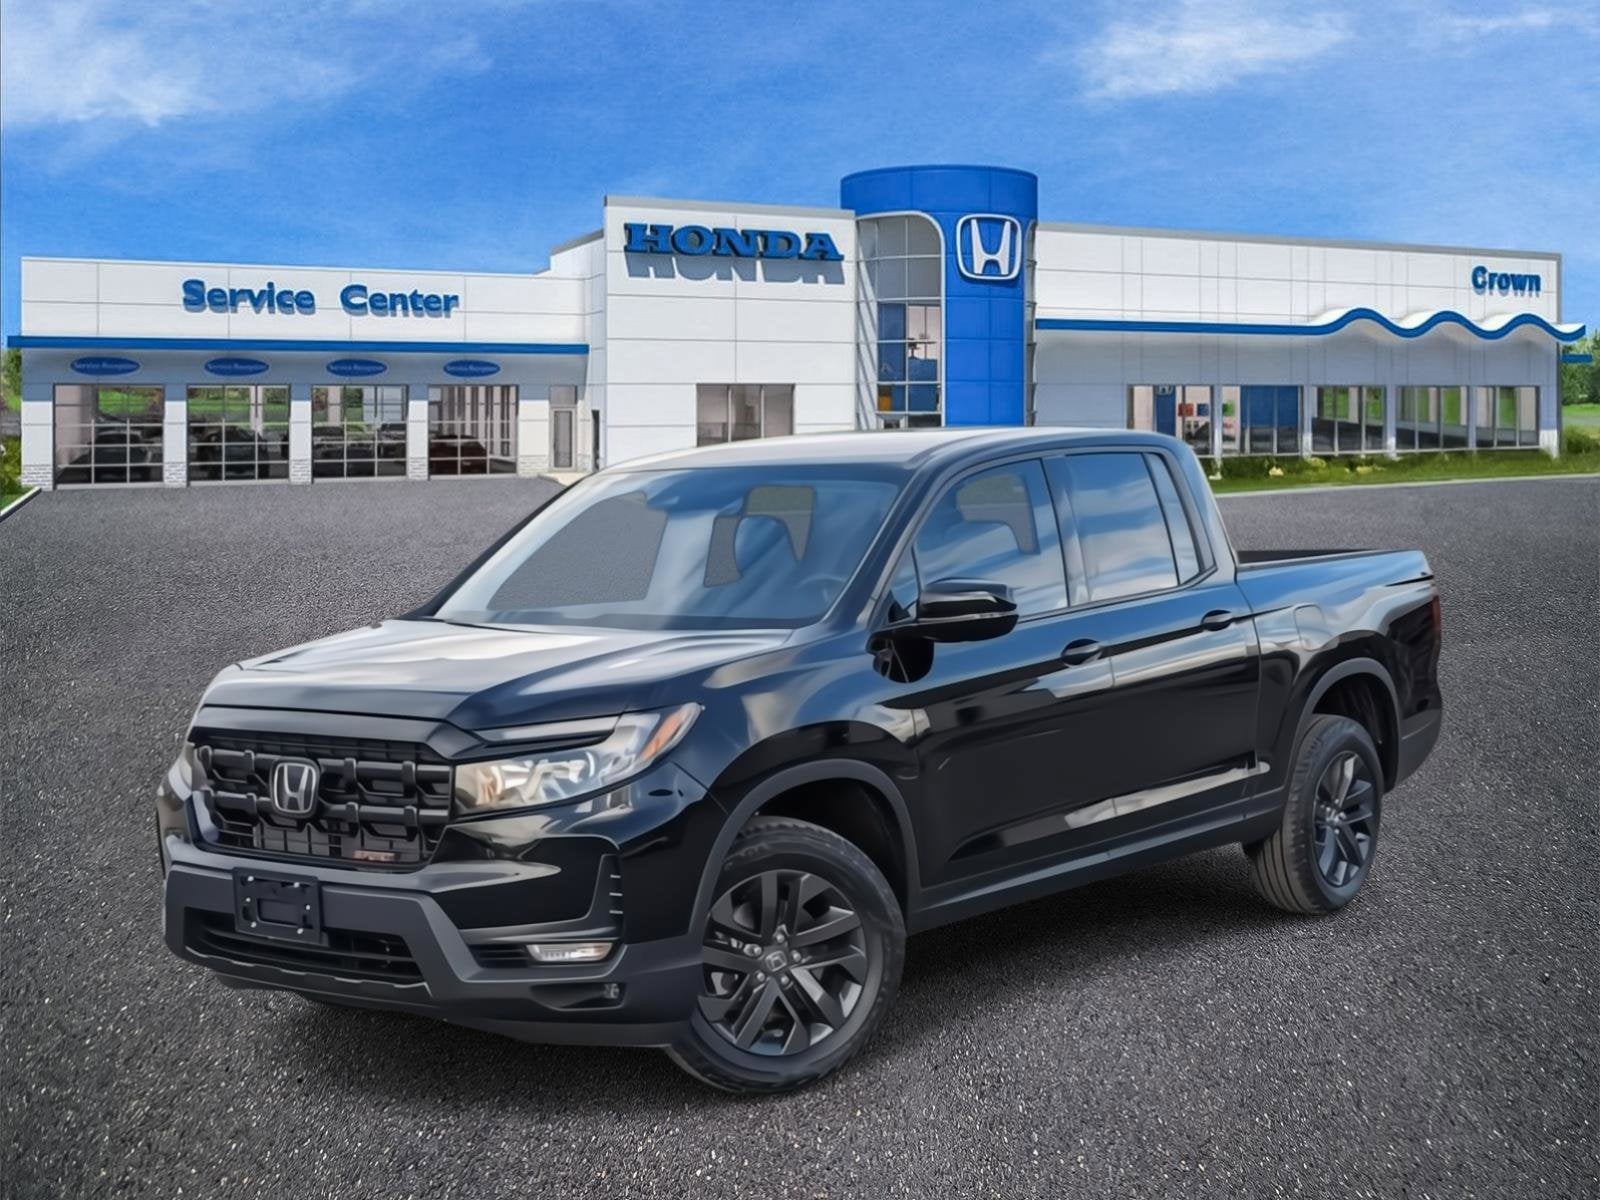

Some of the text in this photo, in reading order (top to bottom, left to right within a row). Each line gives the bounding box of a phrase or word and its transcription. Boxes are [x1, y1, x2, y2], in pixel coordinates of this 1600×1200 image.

[624, 222, 845, 261] HONDA
[1471, 265, 1542, 292] Crown
[182, 279, 460, 314] Service Center
